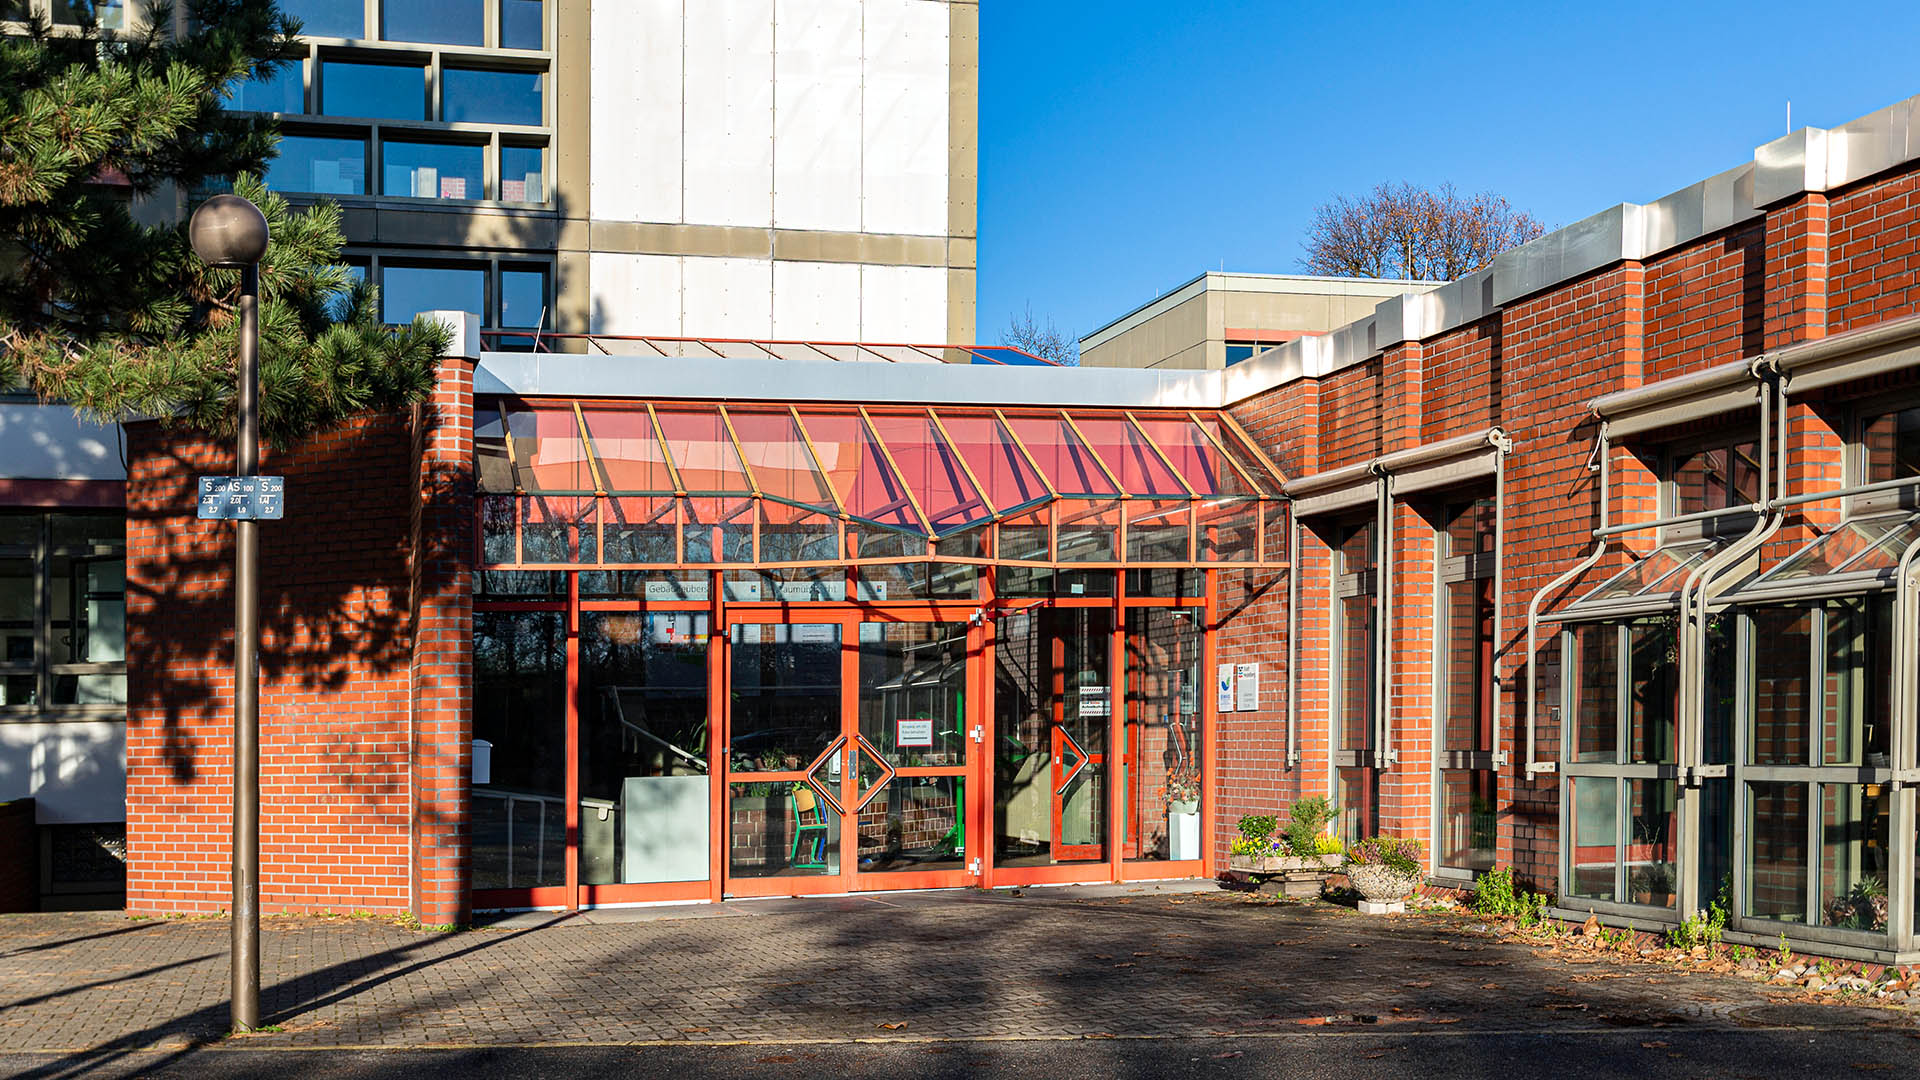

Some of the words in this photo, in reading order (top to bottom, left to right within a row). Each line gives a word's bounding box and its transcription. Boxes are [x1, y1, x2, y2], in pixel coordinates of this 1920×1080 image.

[205, 481, 213, 492] S
[227, 481, 241, 492] AS
[261, 481, 269, 492] S
